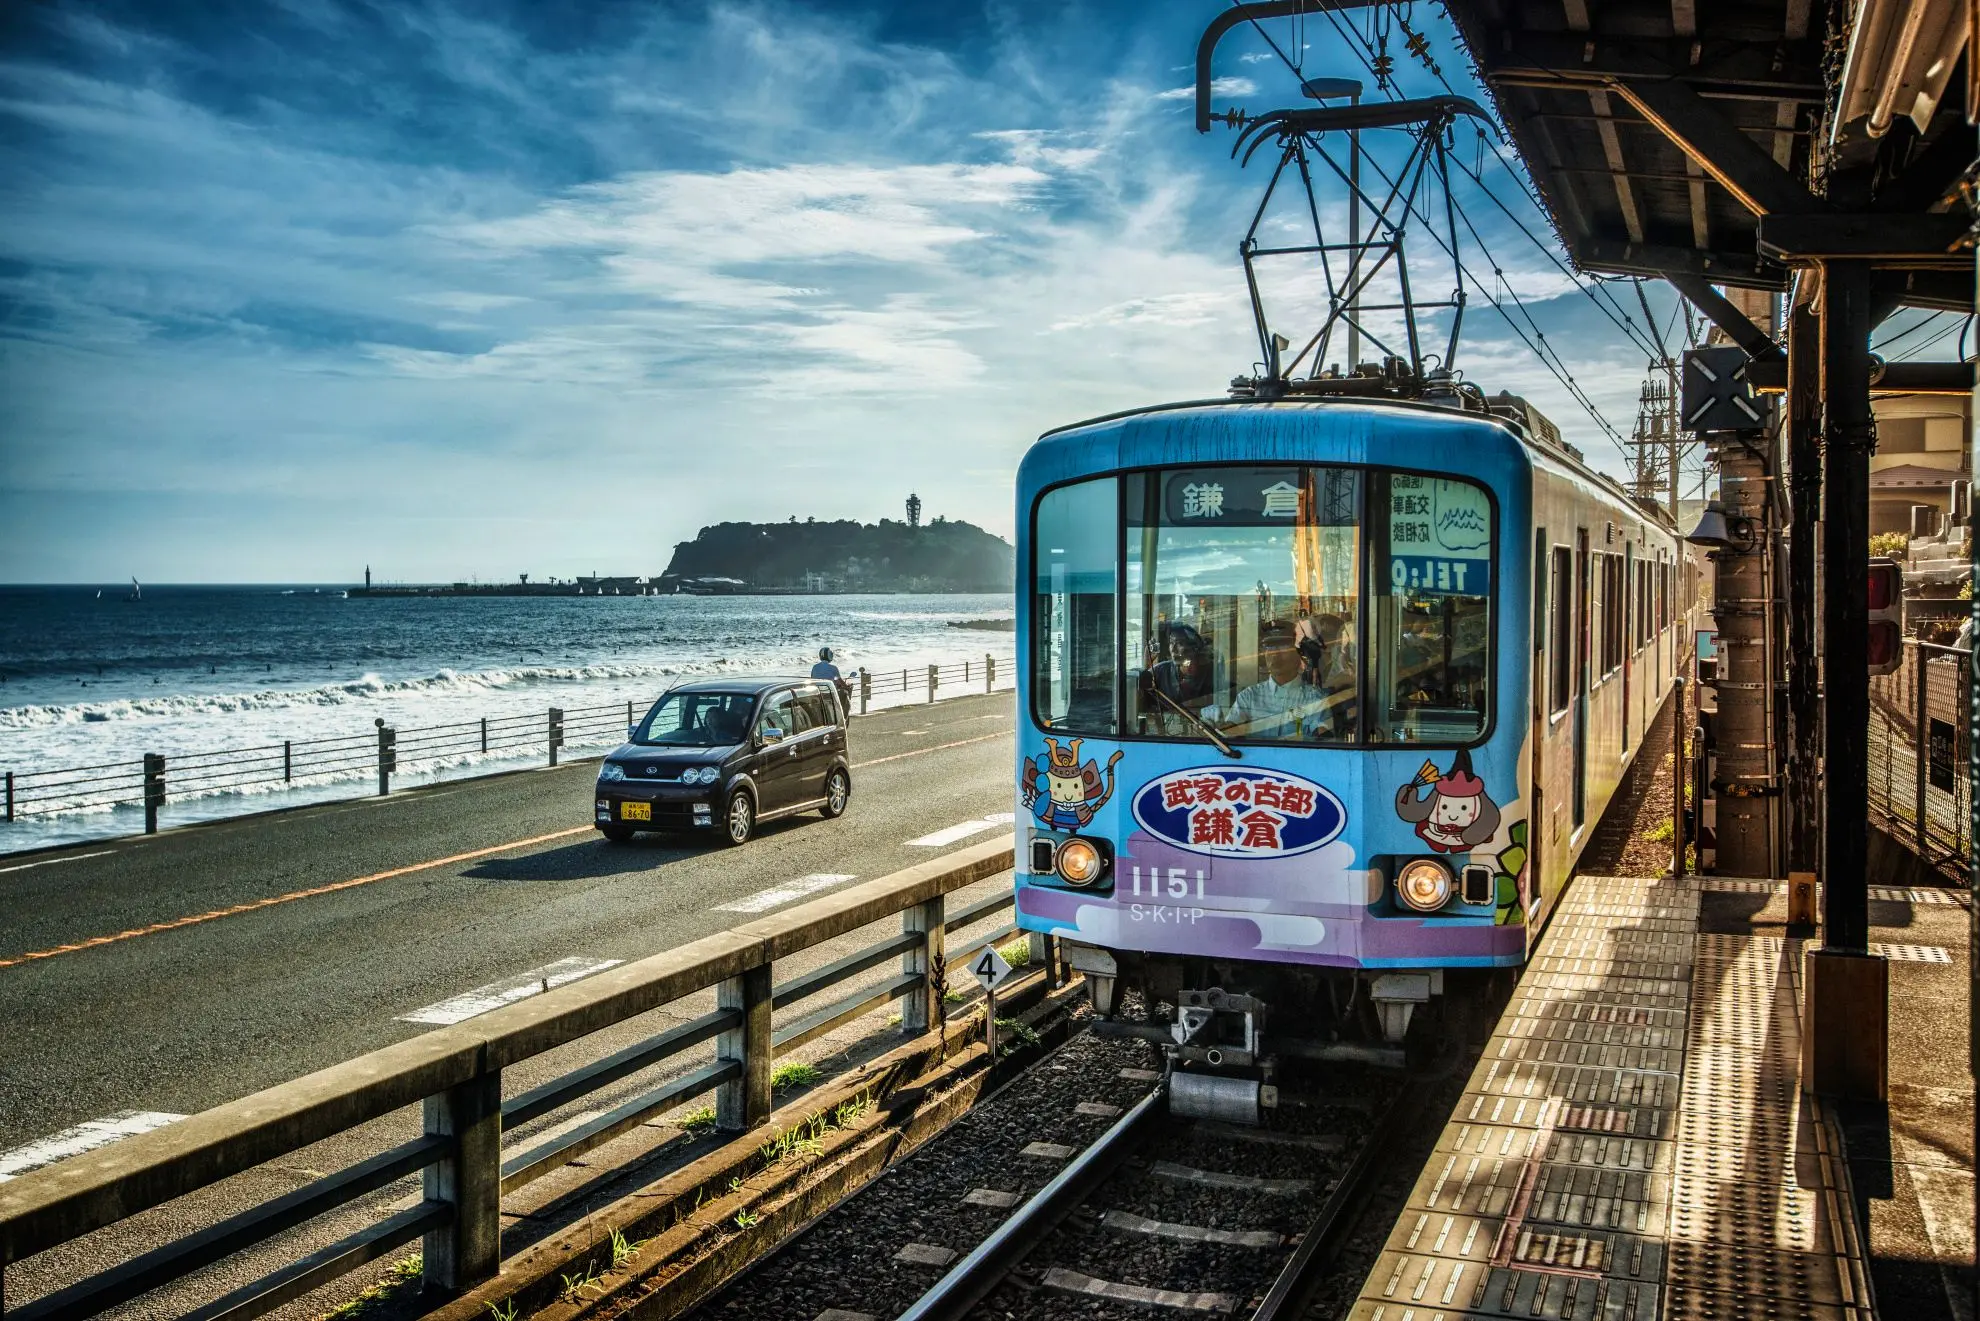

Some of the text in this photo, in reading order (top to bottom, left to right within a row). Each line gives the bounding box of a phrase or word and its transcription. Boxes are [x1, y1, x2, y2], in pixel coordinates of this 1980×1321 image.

[1182, 481, 1304, 517] 鎌倉
[1163, 777, 1314, 815] 武家の古都
[1192, 807, 1282, 849] 鎌倉
[1132, 866, 1204, 900] 1151
[976, 952, 997, 985] 4
